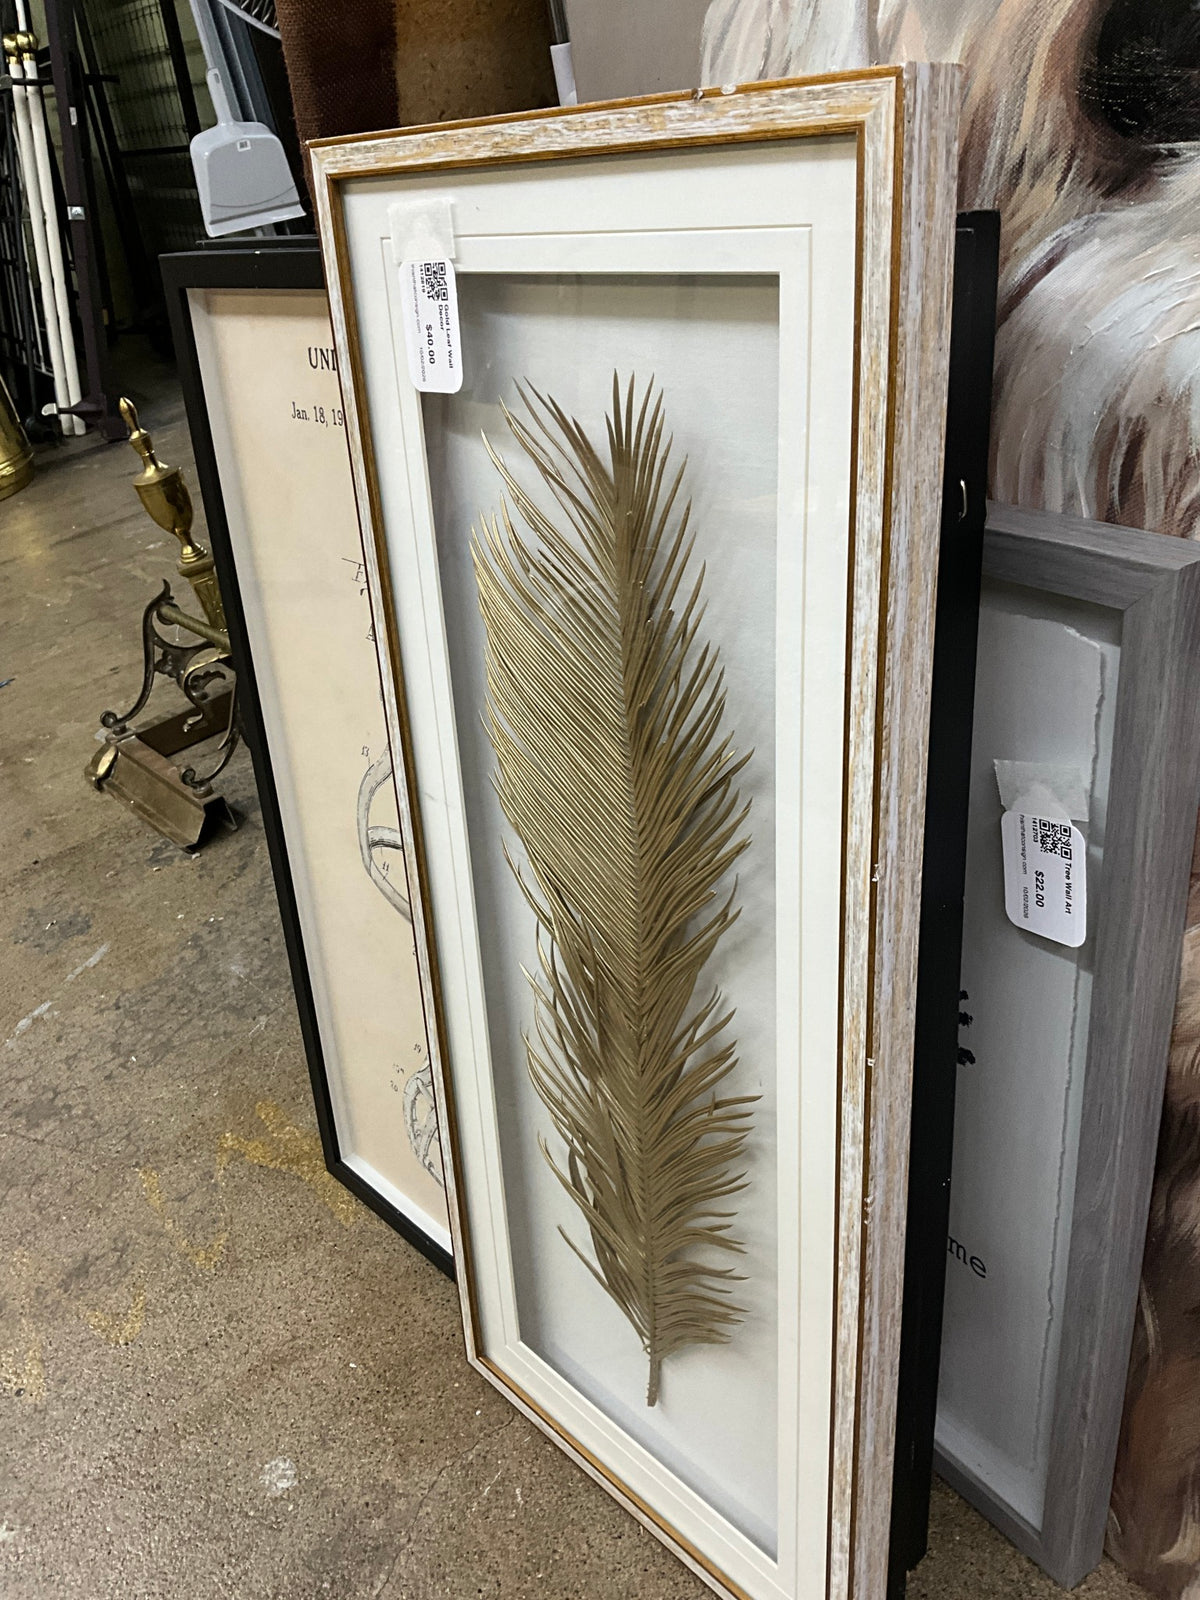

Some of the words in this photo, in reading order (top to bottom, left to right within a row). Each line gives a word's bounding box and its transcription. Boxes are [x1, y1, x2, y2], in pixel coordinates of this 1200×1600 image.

[425, 324, 436, 365] $40.00
[291, 401, 310, 421] Jan.
[313, 405, 329, 428] 18,
[1064, 862, 1072, 880] Tree
[1035, 870, 1044, 908] $22.00
[1064, 882, 1072, 900] Wall
[1064, 901, 1072, 914] Art
[946, 1235, 986, 1278] me
